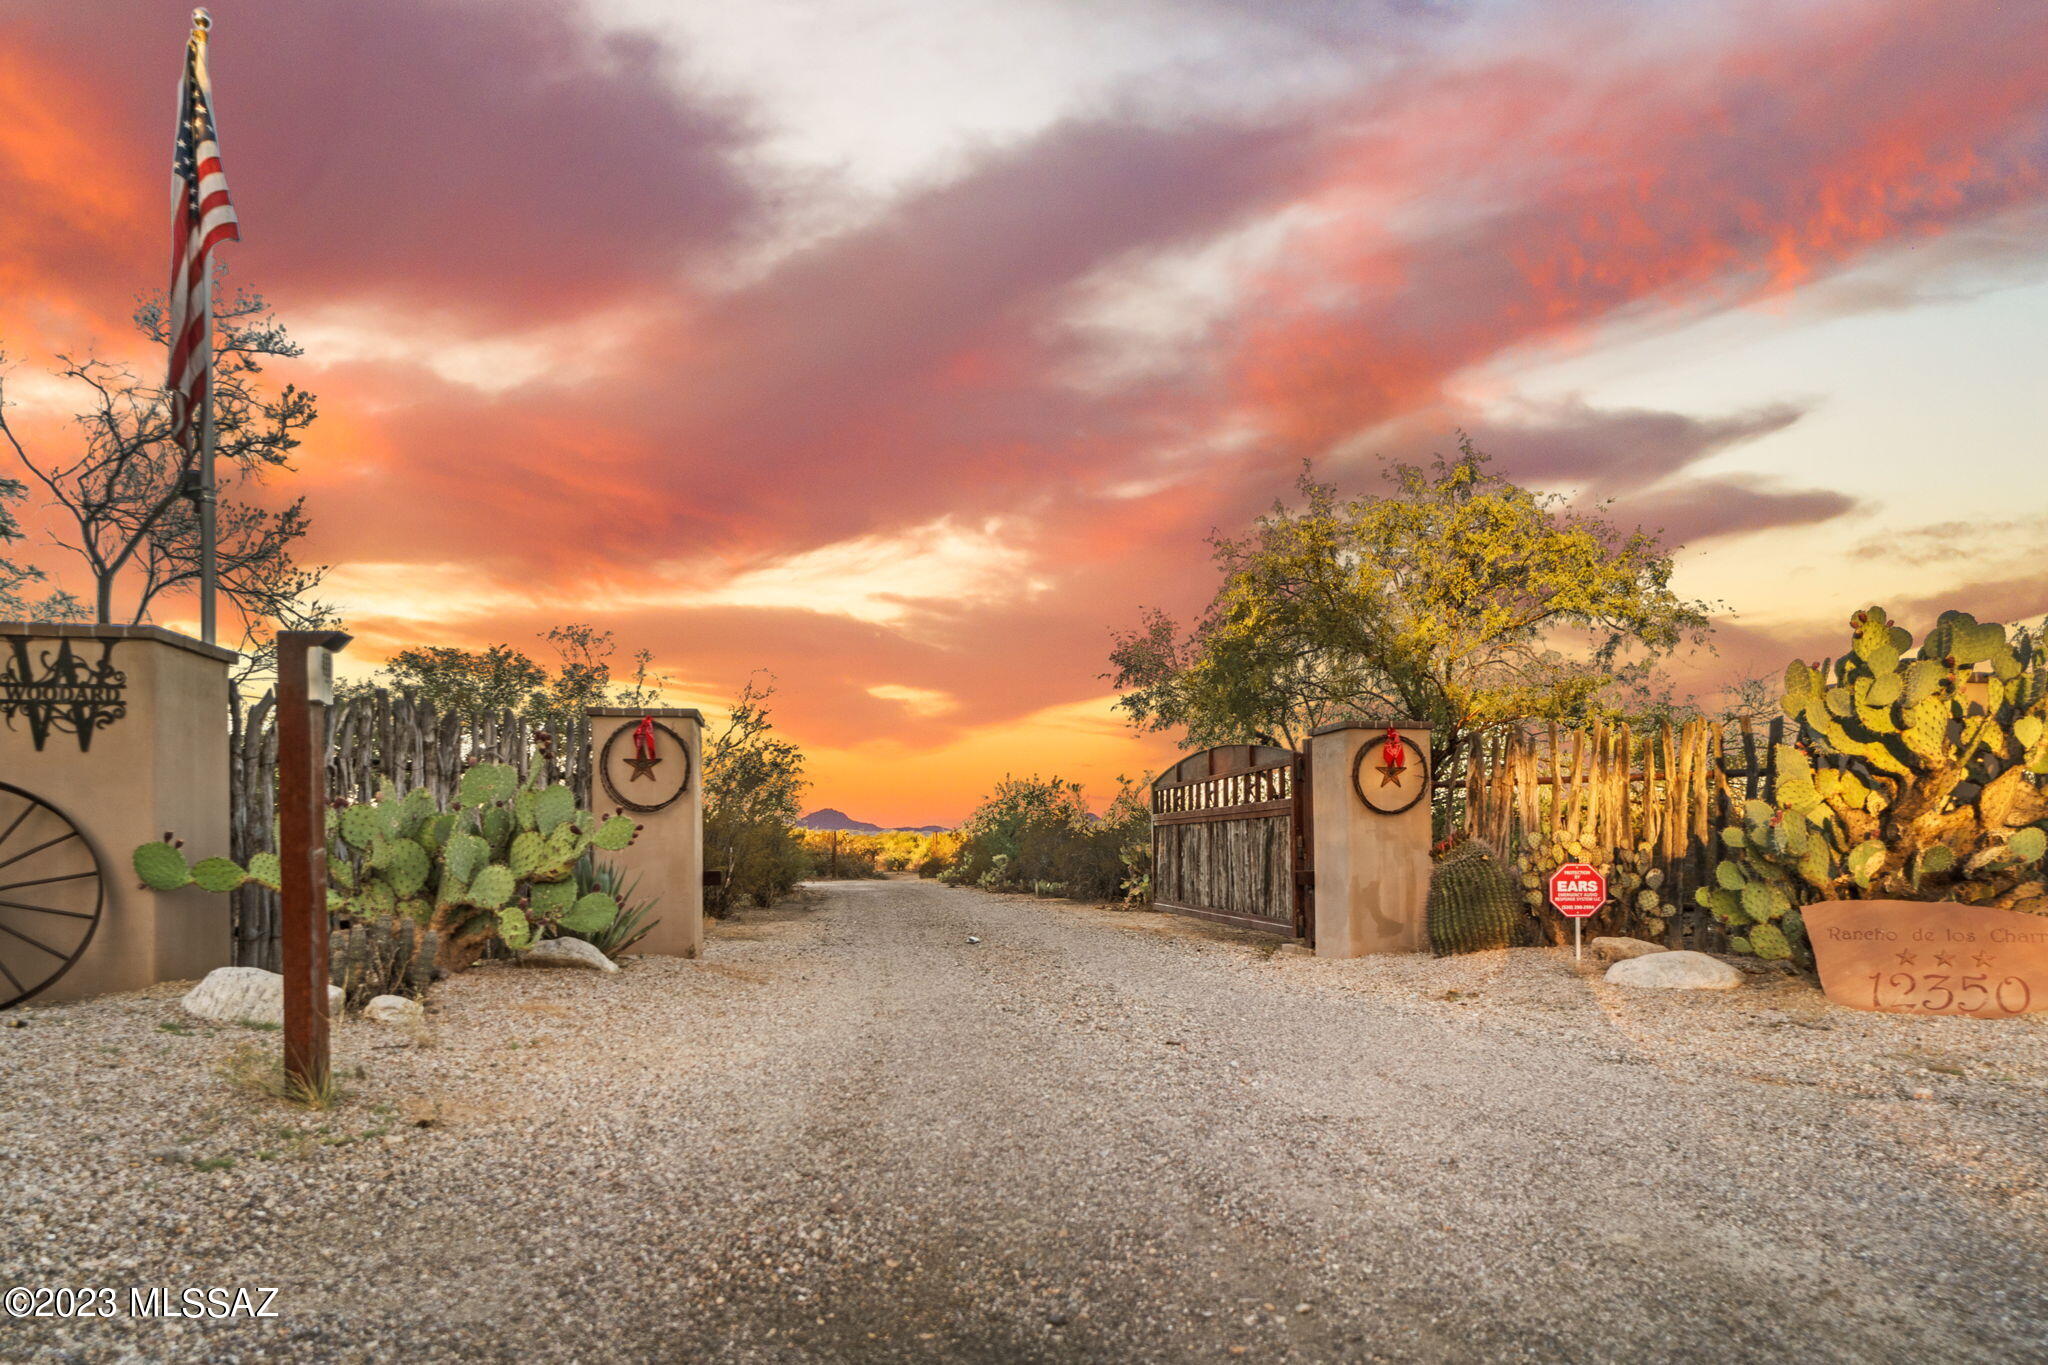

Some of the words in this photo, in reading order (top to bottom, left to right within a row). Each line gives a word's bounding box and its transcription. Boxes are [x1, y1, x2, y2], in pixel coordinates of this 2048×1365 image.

[3, 686, 120, 702] WOODARD
[1557, 880, 1598, 892] EARS
[1827, 926, 1898, 942] Rancho
[1912, 927, 1935, 942] de
[1946, 928, 1976, 942] los
[1868, 971, 2031, 1014] 12350
